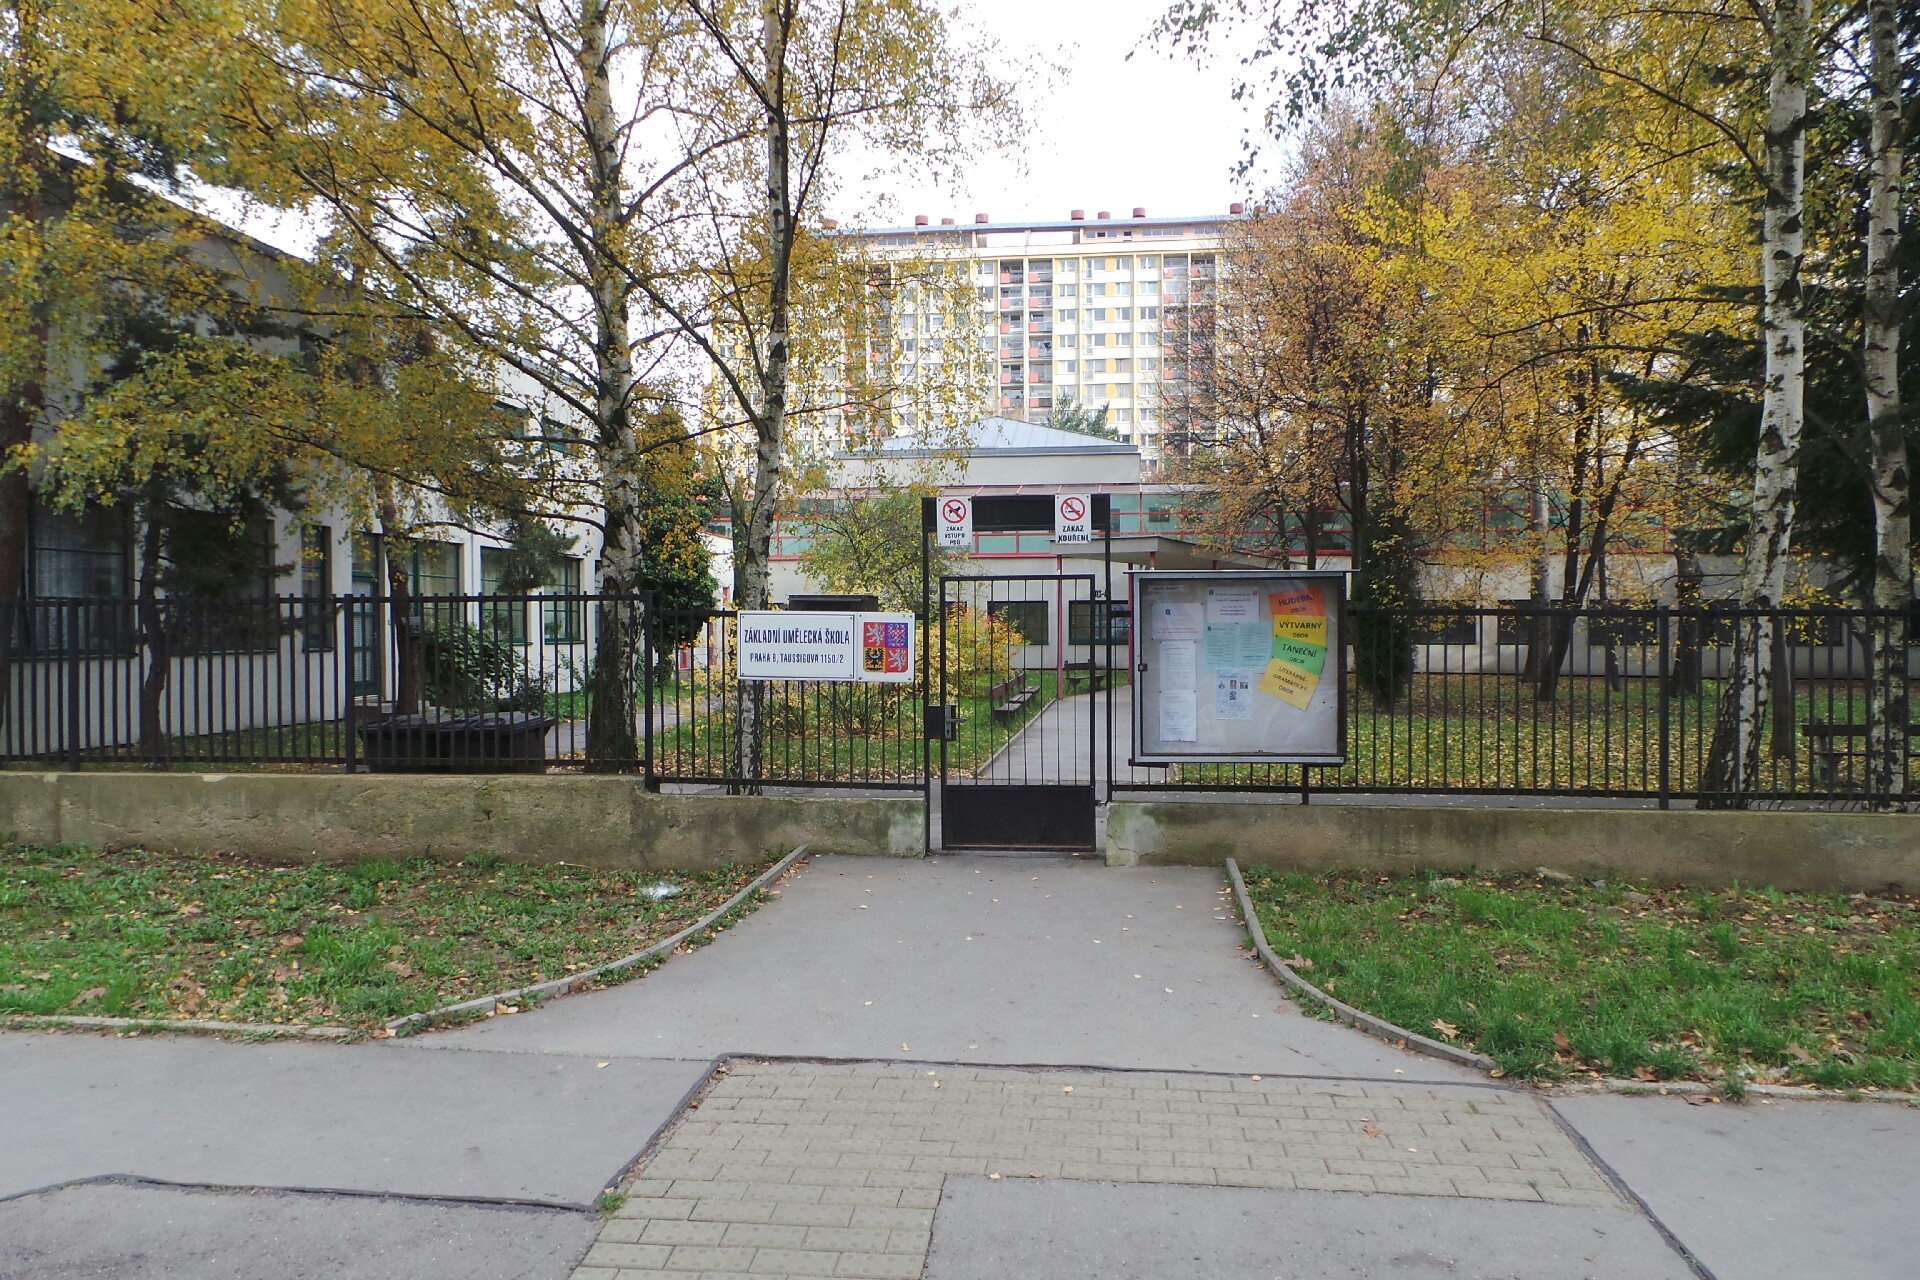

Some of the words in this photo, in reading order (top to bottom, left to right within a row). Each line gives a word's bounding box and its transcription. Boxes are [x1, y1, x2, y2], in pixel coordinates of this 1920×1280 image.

[1062, 524, 1084, 532] ZÁKAZ
[1058, 534, 1089, 542] KOUŘENÍ
[1279, 620, 1322, 629] VÝTVARNÝ
[744, 627, 780, 643] ZÁKLADNÍ
[783, 627, 822, 644] UMĚLECKÁ
[825, 628, 850, 644] ŠKOLA
[1282, 643, 1318, 658] TANEČNÍ
[750, 653, 770, 662] PRAHA
[780, 653, 818, 663] TAUSSIGOVA
[820, 654, 844, 663] 1150/2
